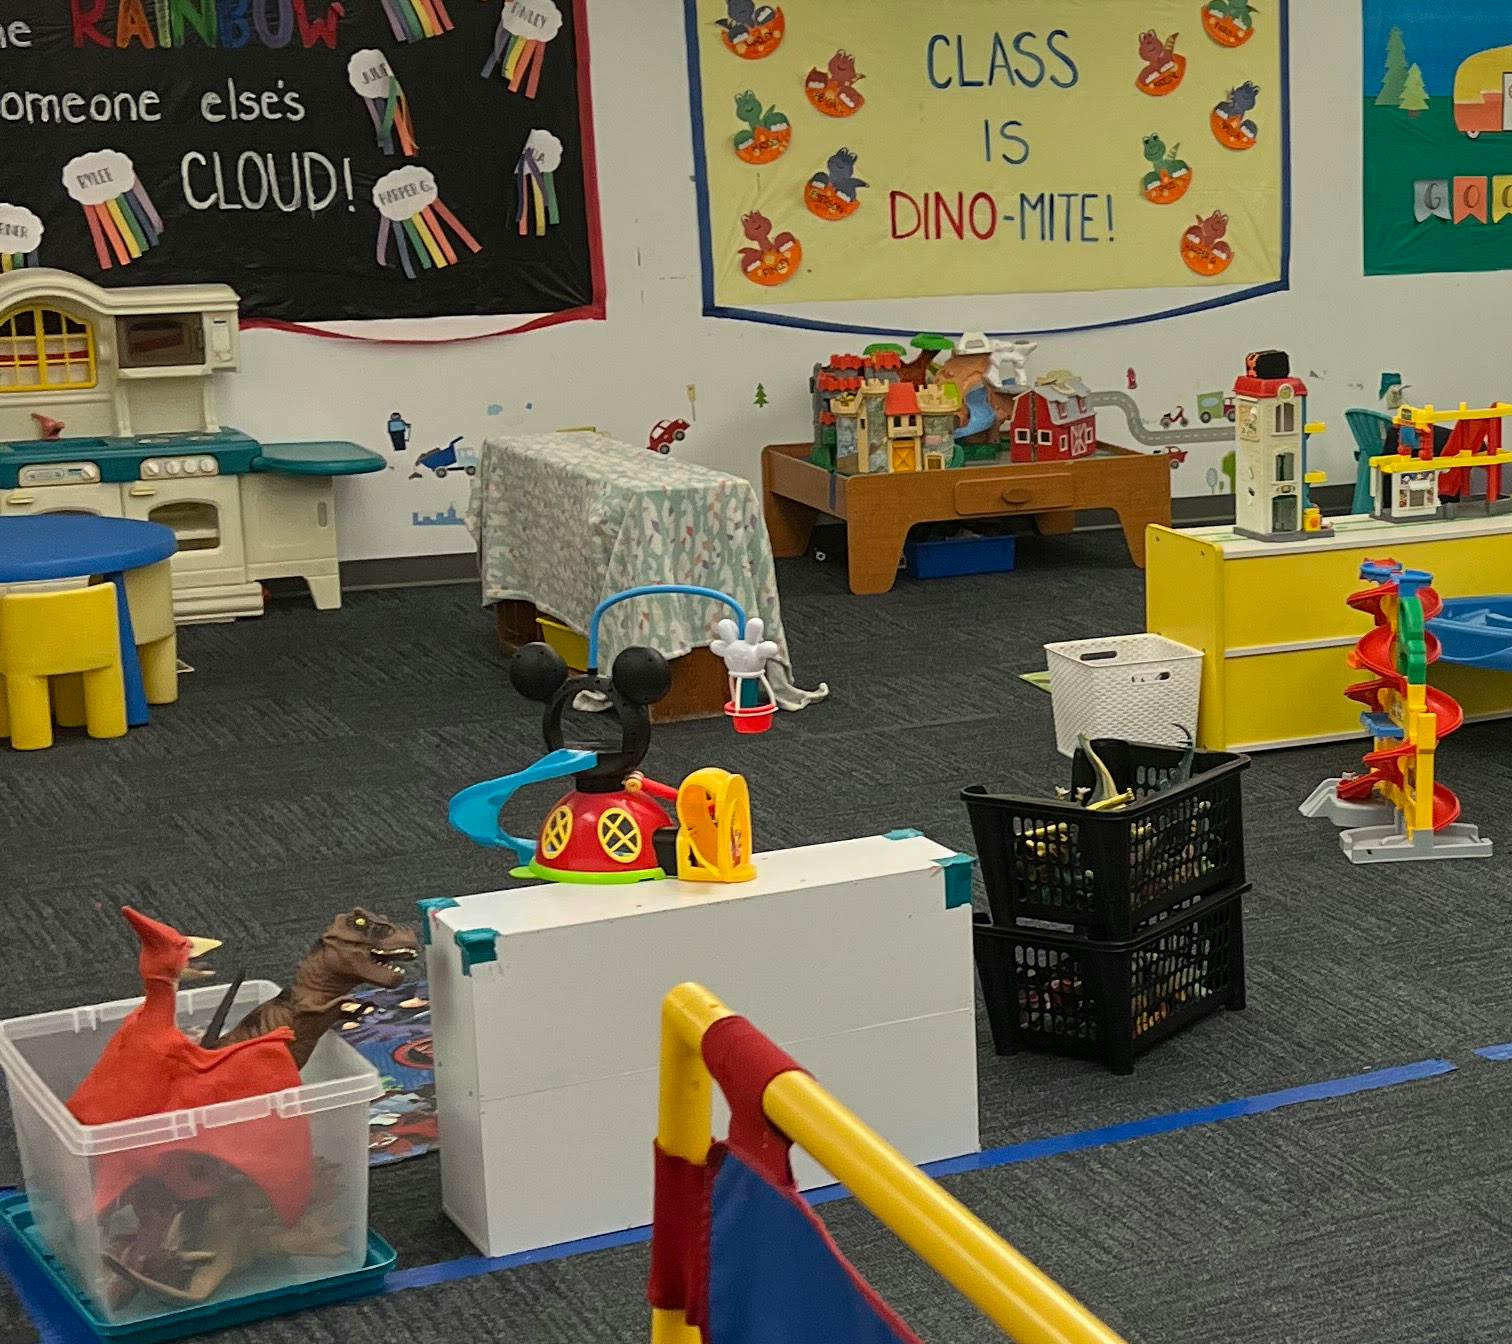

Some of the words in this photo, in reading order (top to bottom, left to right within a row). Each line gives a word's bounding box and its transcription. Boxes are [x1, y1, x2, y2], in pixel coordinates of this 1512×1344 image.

[926, 29, 1079, 89] CLASS
[0, 90, 162, 124] omeone
[200, 77, 306, 122] else's
[983, 119, 1030, 165] IS
[181, 151, 356, 213] CLOUD!
[890, 190, 1115, 243] DINO-MITE!
